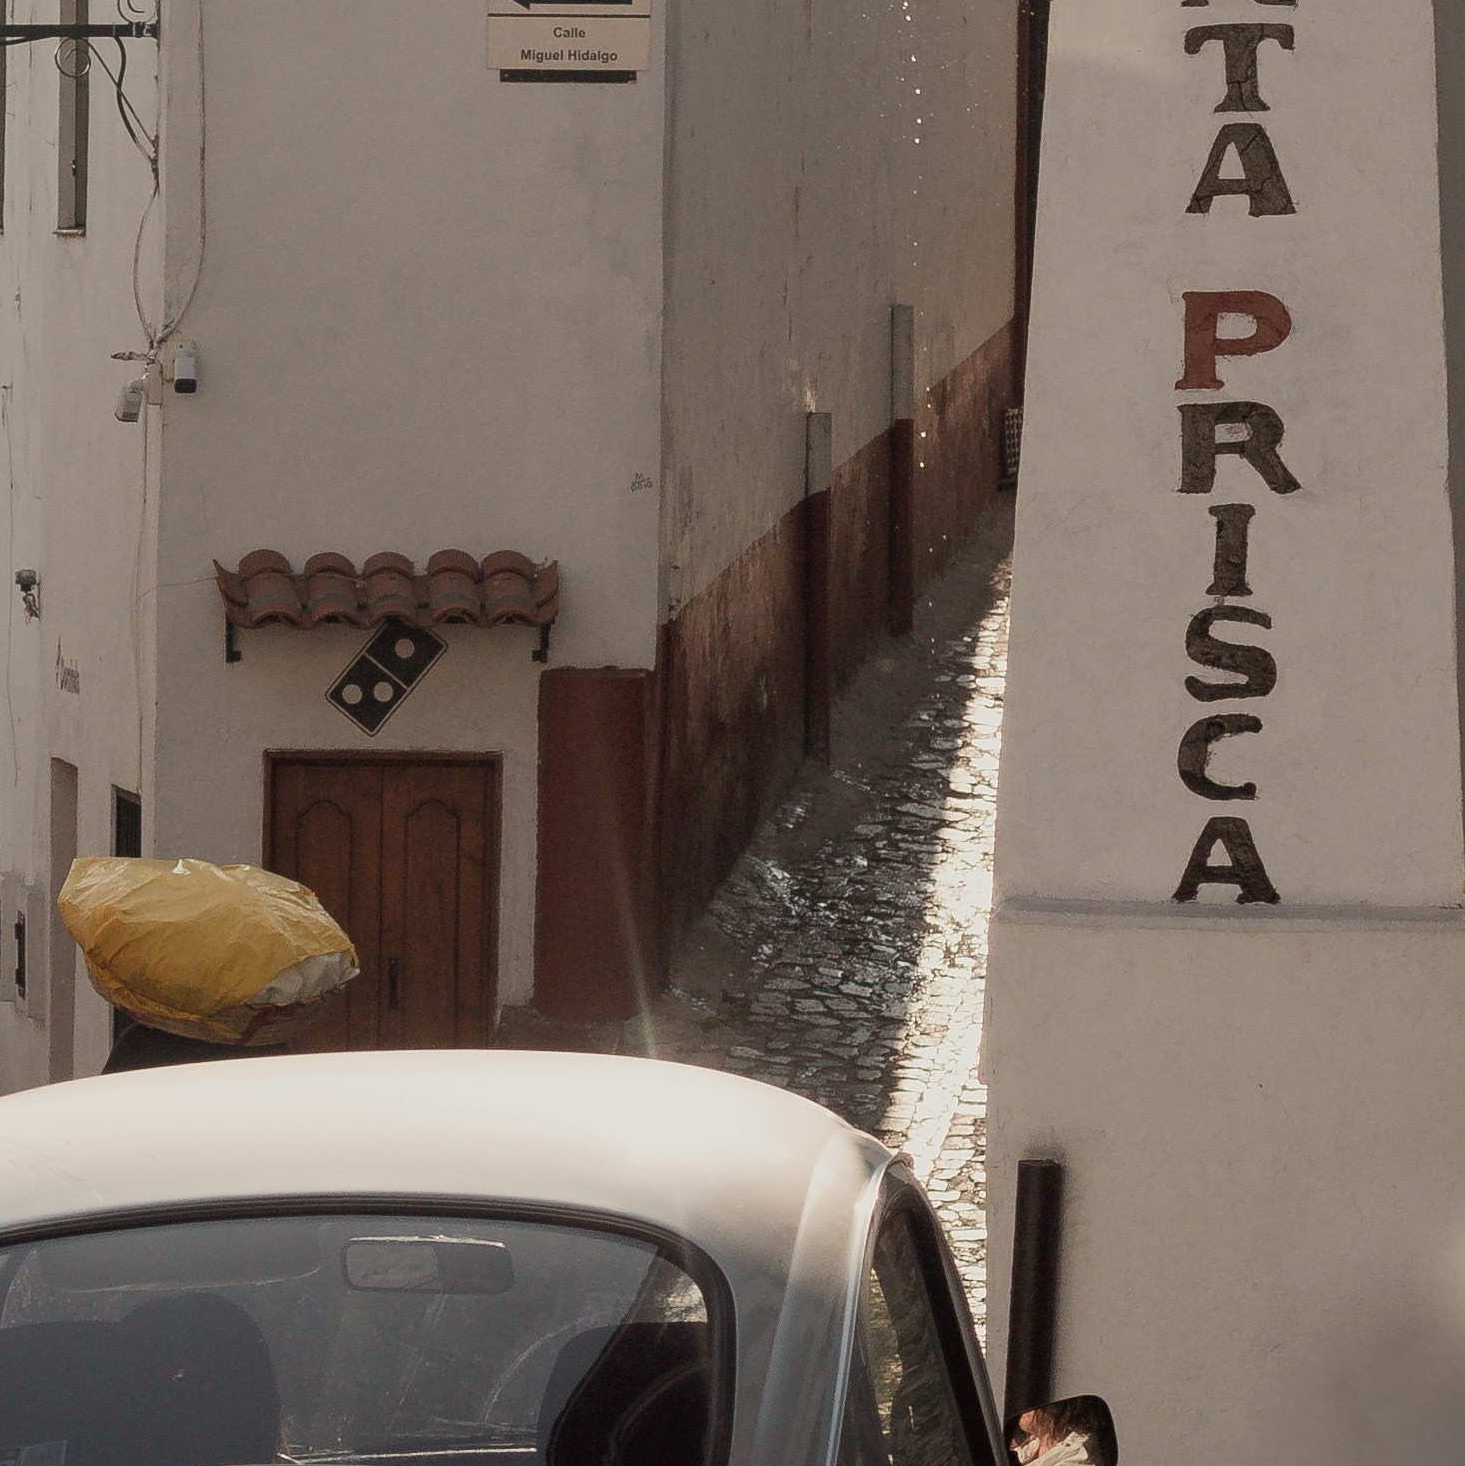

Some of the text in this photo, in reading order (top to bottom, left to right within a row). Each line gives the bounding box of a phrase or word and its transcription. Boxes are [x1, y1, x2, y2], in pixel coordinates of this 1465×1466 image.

[553, 27, 586, 38] Calle
[521, 49, 618, 63] Miguel Hidalgo
[1172, 290, 1301, 904] PRISCA
